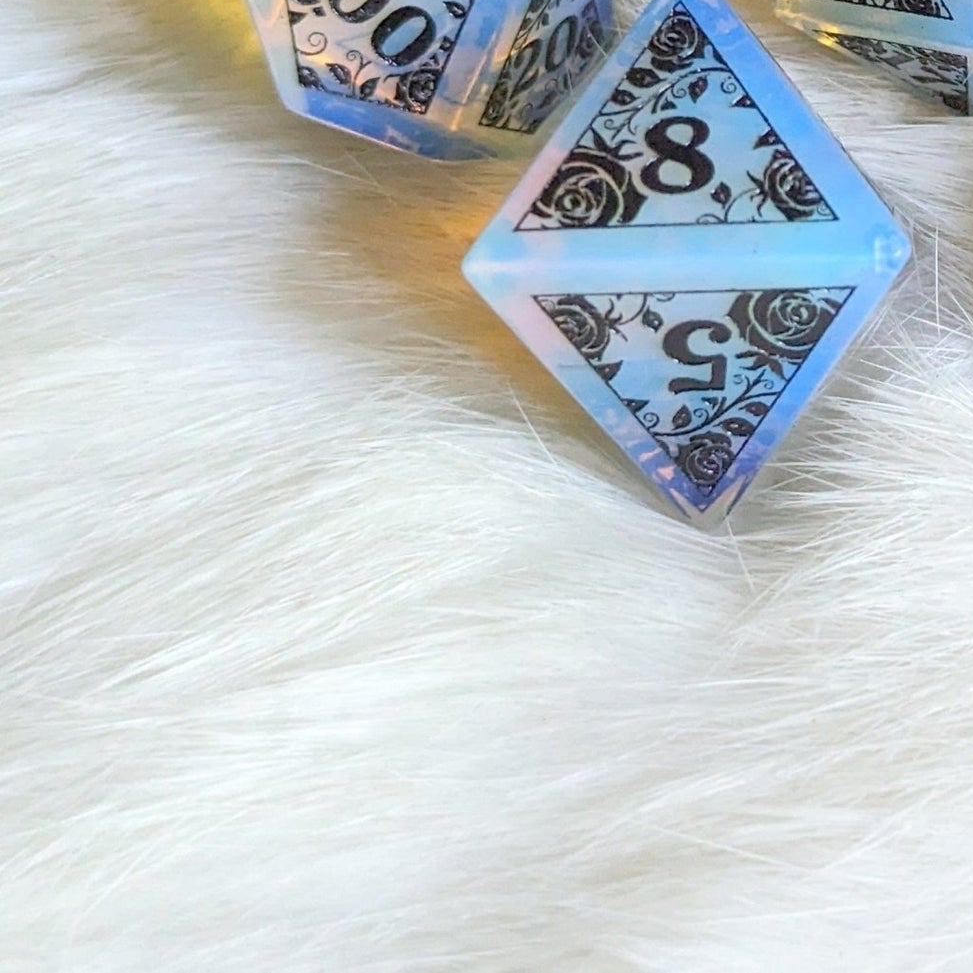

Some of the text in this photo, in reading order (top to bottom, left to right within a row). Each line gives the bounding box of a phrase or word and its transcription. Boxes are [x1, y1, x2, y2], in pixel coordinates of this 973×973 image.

[508, 14, 577, 101] 20
[640, 116, 715, 195] 8
[662, 319, 731, 395] 5
